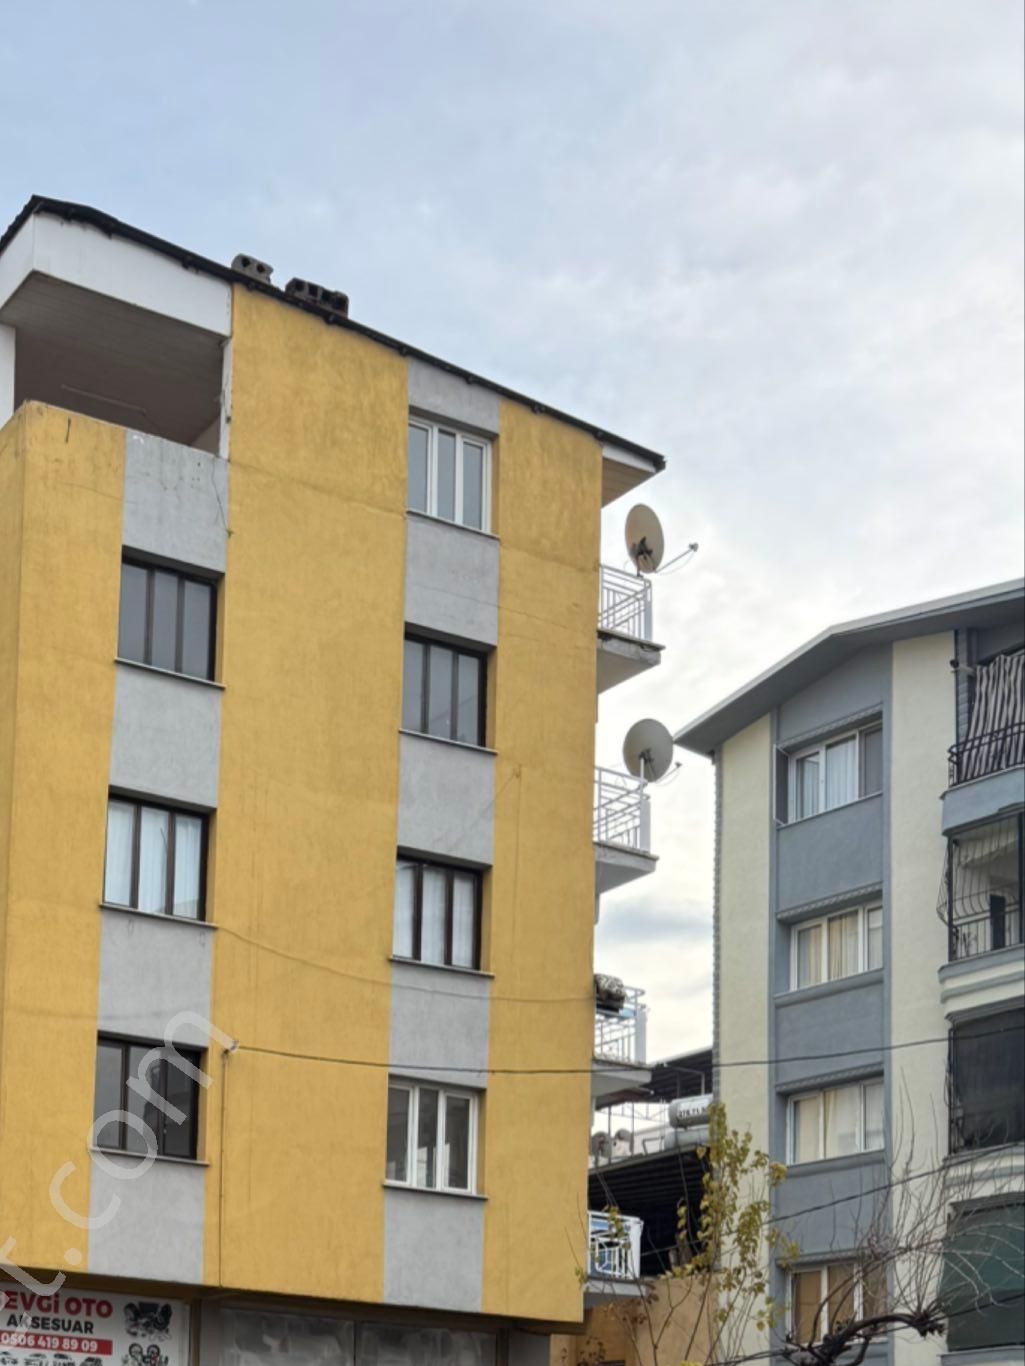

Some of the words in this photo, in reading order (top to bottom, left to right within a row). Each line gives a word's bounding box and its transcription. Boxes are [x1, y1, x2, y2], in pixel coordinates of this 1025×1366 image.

[64, 1299, 113, 1318] OTO
[6, 1314, 94, 1334] AKSESUAR
[1, 1332, 34, 1347] 0506
[37, 1336, 58, 1349] 419
[62, 1338, 78, 1351] 89
[81, 1340, 98, 1352] 09
